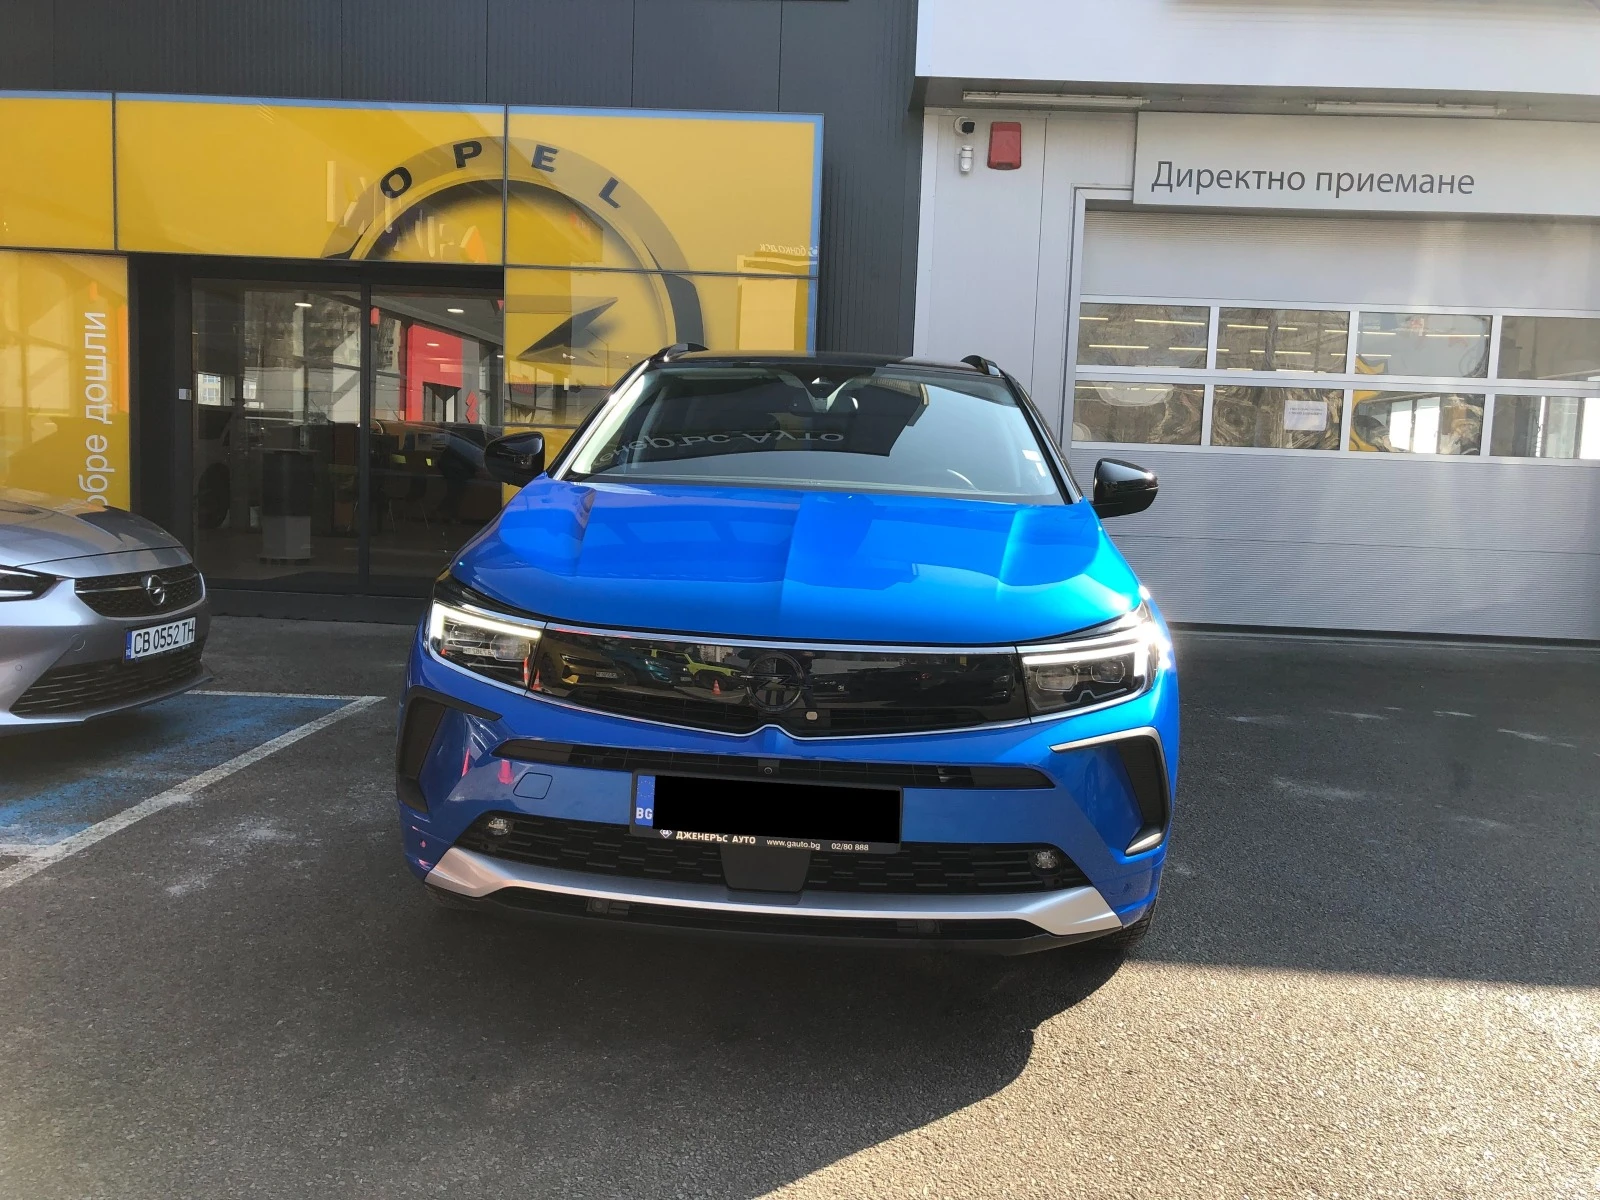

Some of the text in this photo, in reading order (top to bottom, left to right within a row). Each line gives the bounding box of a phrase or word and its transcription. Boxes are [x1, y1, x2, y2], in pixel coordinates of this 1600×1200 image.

[380, 140, 621, 209] OPEL
[1151, 160, 1475, 198] Директно приемане
[84, 312, 113, 425] дошли
[153, 624, 180, 650] 0552
[635, 806, 653, 820] BG
[731, 835, 756, 845] АУТО
[766, 839, 821, 850] www.gauto.bg
[831, 842, 869, 851] 02/80 888
